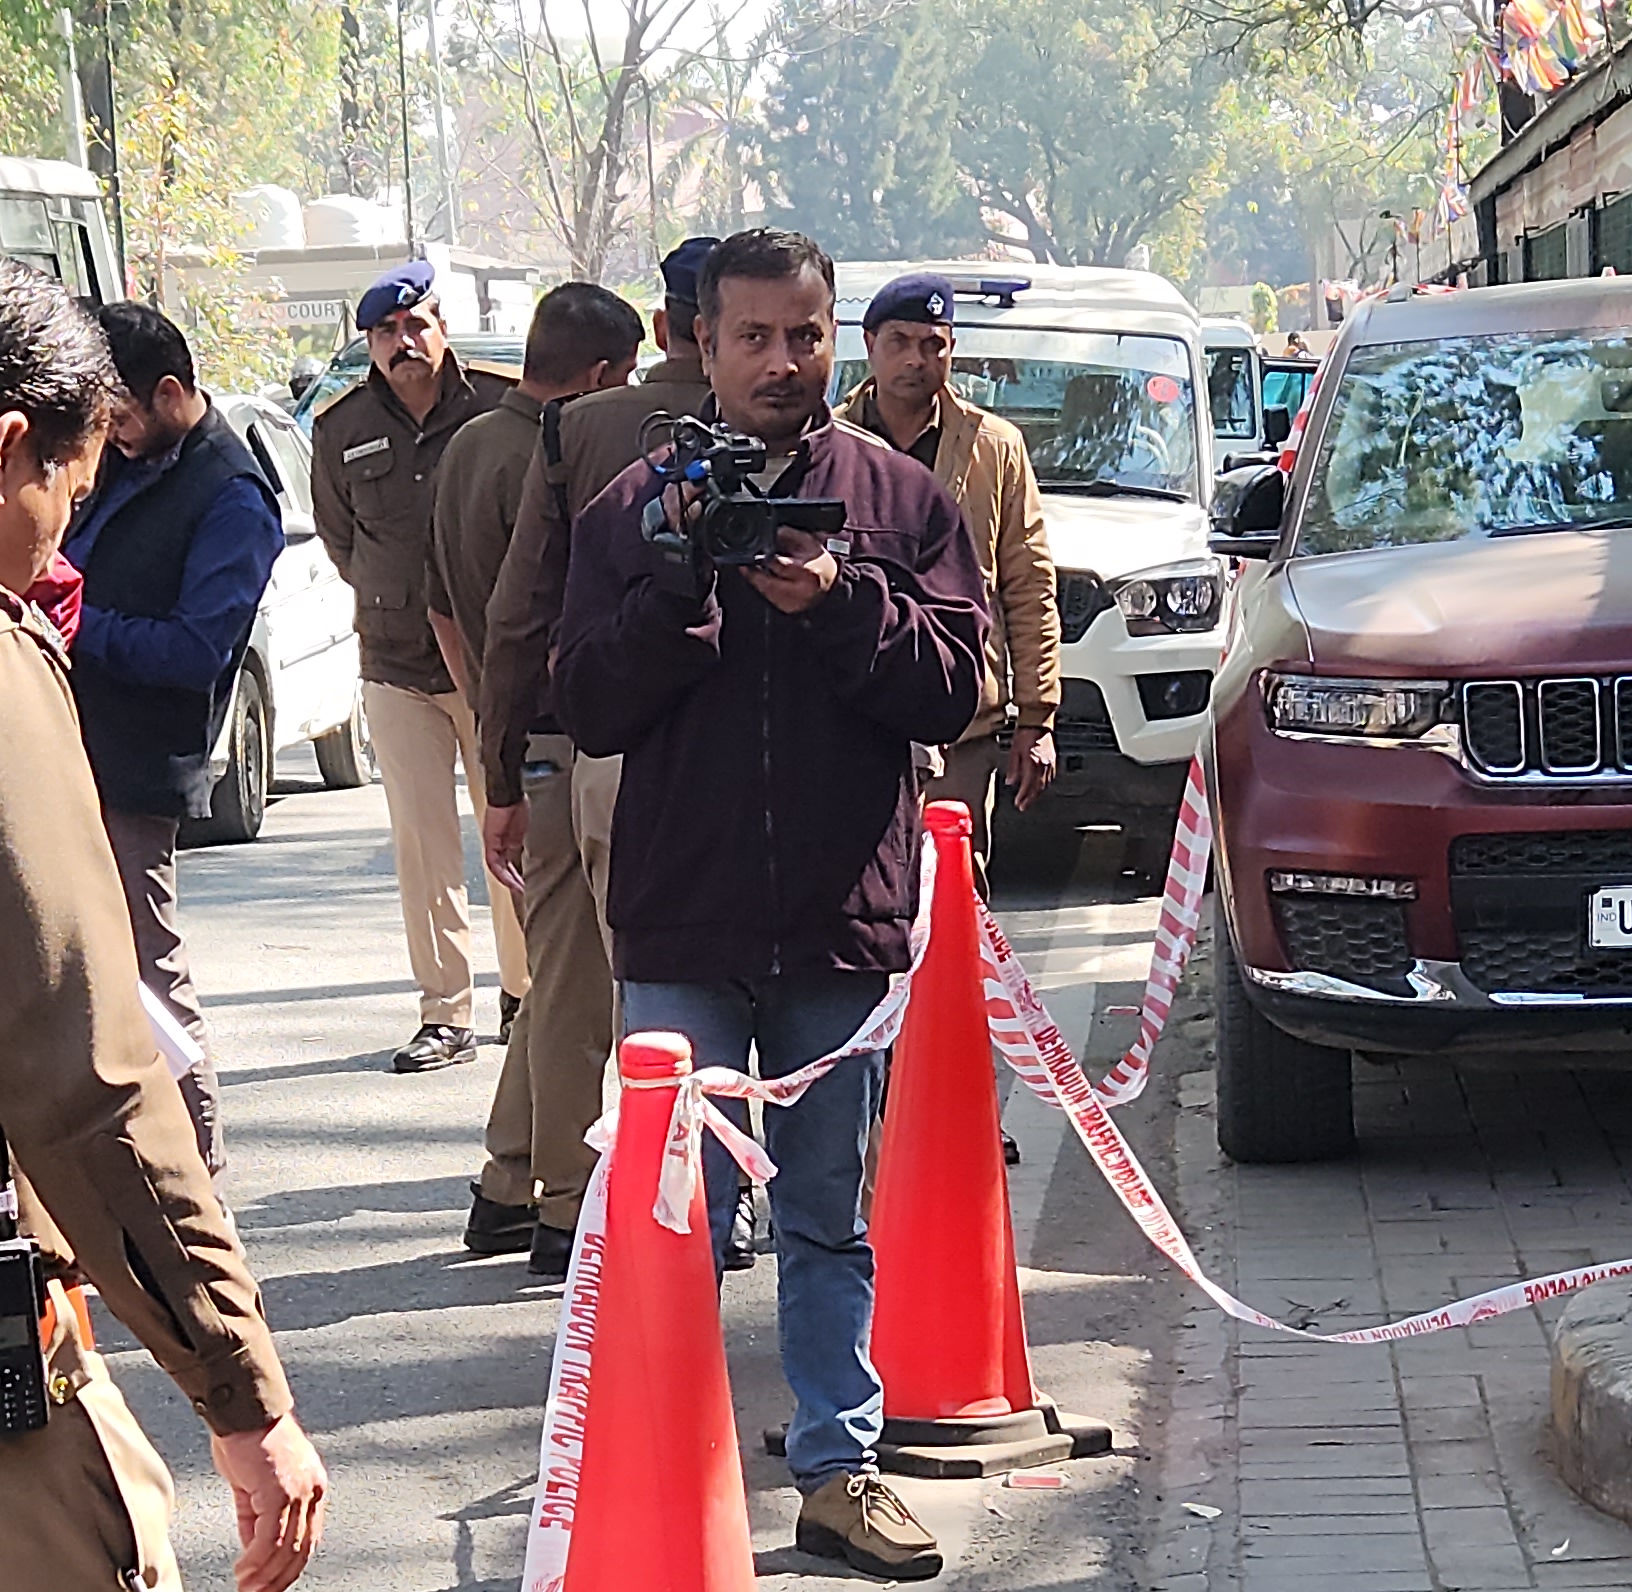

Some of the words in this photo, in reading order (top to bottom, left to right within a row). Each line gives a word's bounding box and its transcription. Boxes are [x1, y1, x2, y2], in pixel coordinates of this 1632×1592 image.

[288, 302, 343, 319] COURT
[1597, 911, 1617, 923] IND
[1034, 1025, 1094, 1107] DEHRADUN
